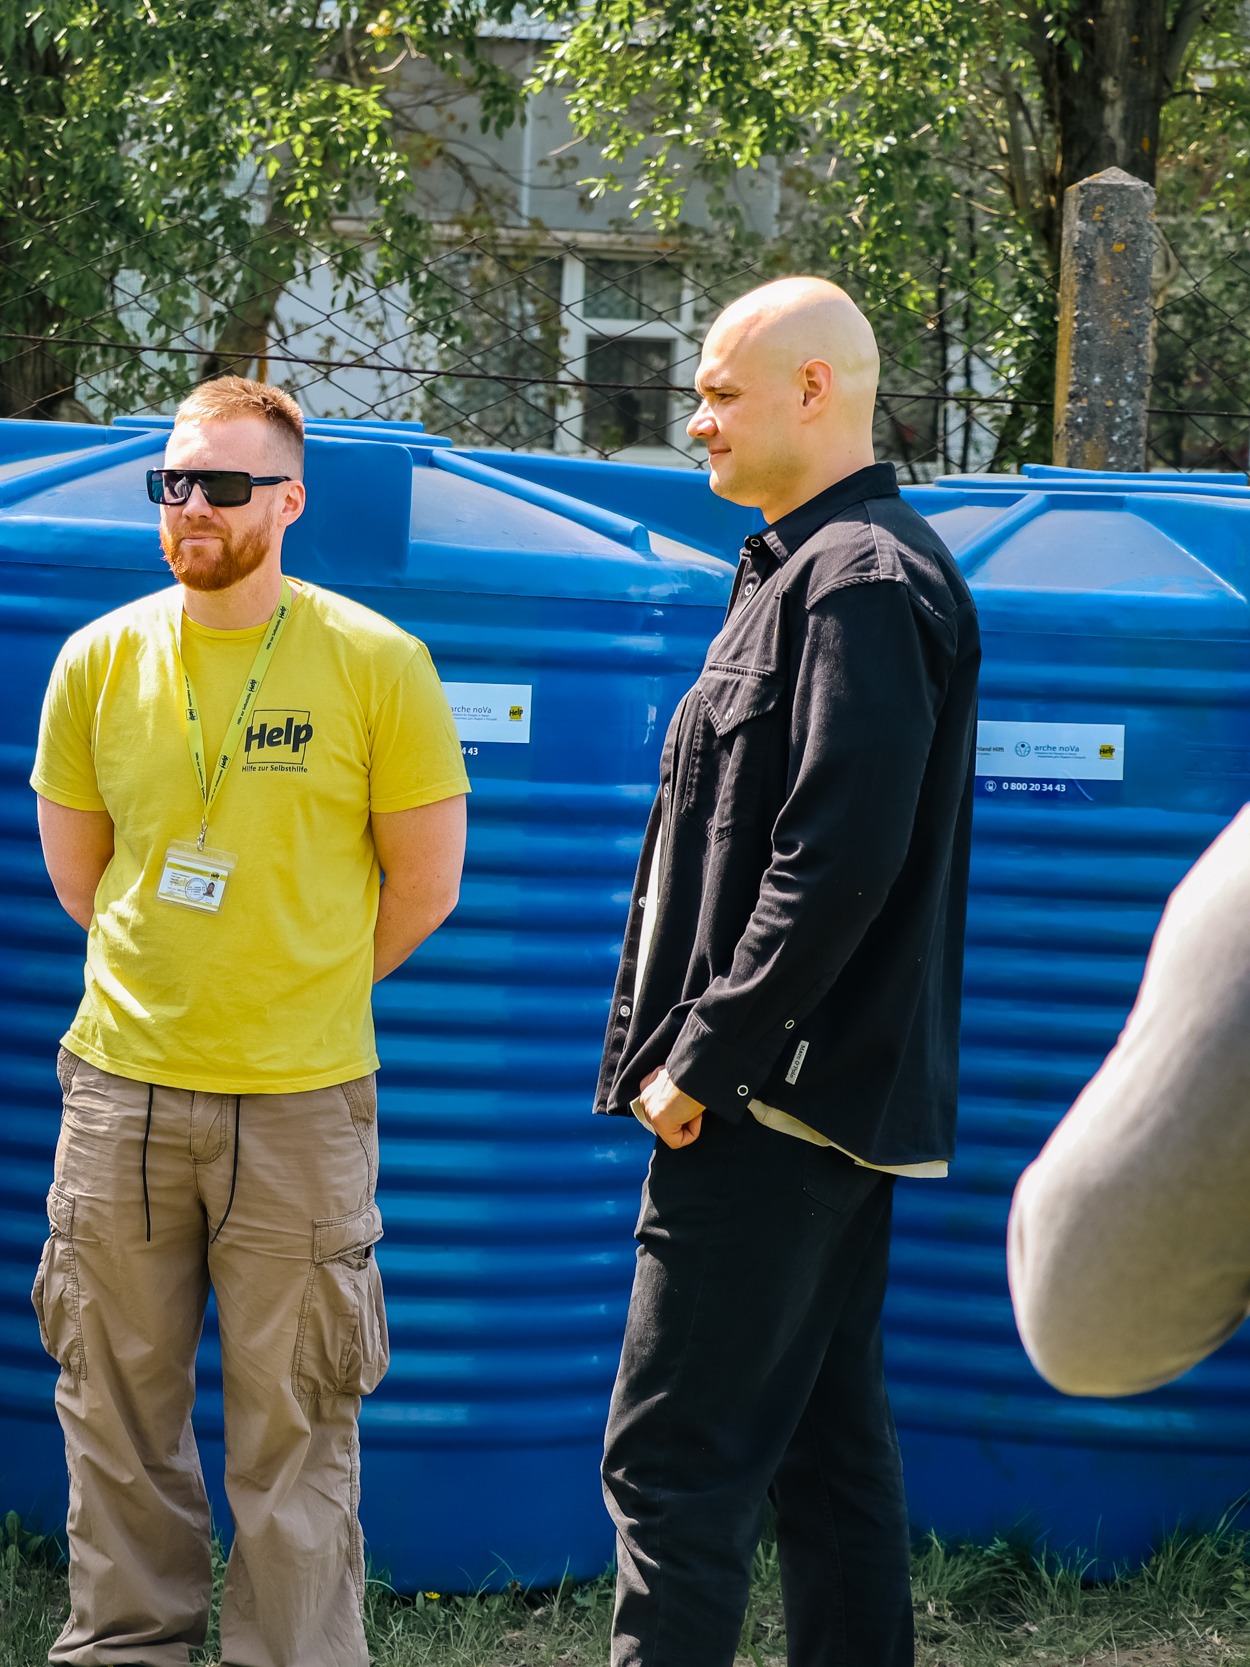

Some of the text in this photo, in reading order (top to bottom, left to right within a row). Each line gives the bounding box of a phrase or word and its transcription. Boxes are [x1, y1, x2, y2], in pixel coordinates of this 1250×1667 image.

[450, 705, 492, 714] arche noVa
[509, 708, 523, 717] Help
[244, 717, 314, 753] Help
[467, 748, 478, 756] 43
[1099, 747, 1116, 755] Help
[270, 764, 308, 773] Selbsthilfe
[1002, 782, 1066, 792] 0 800 20 34 43
